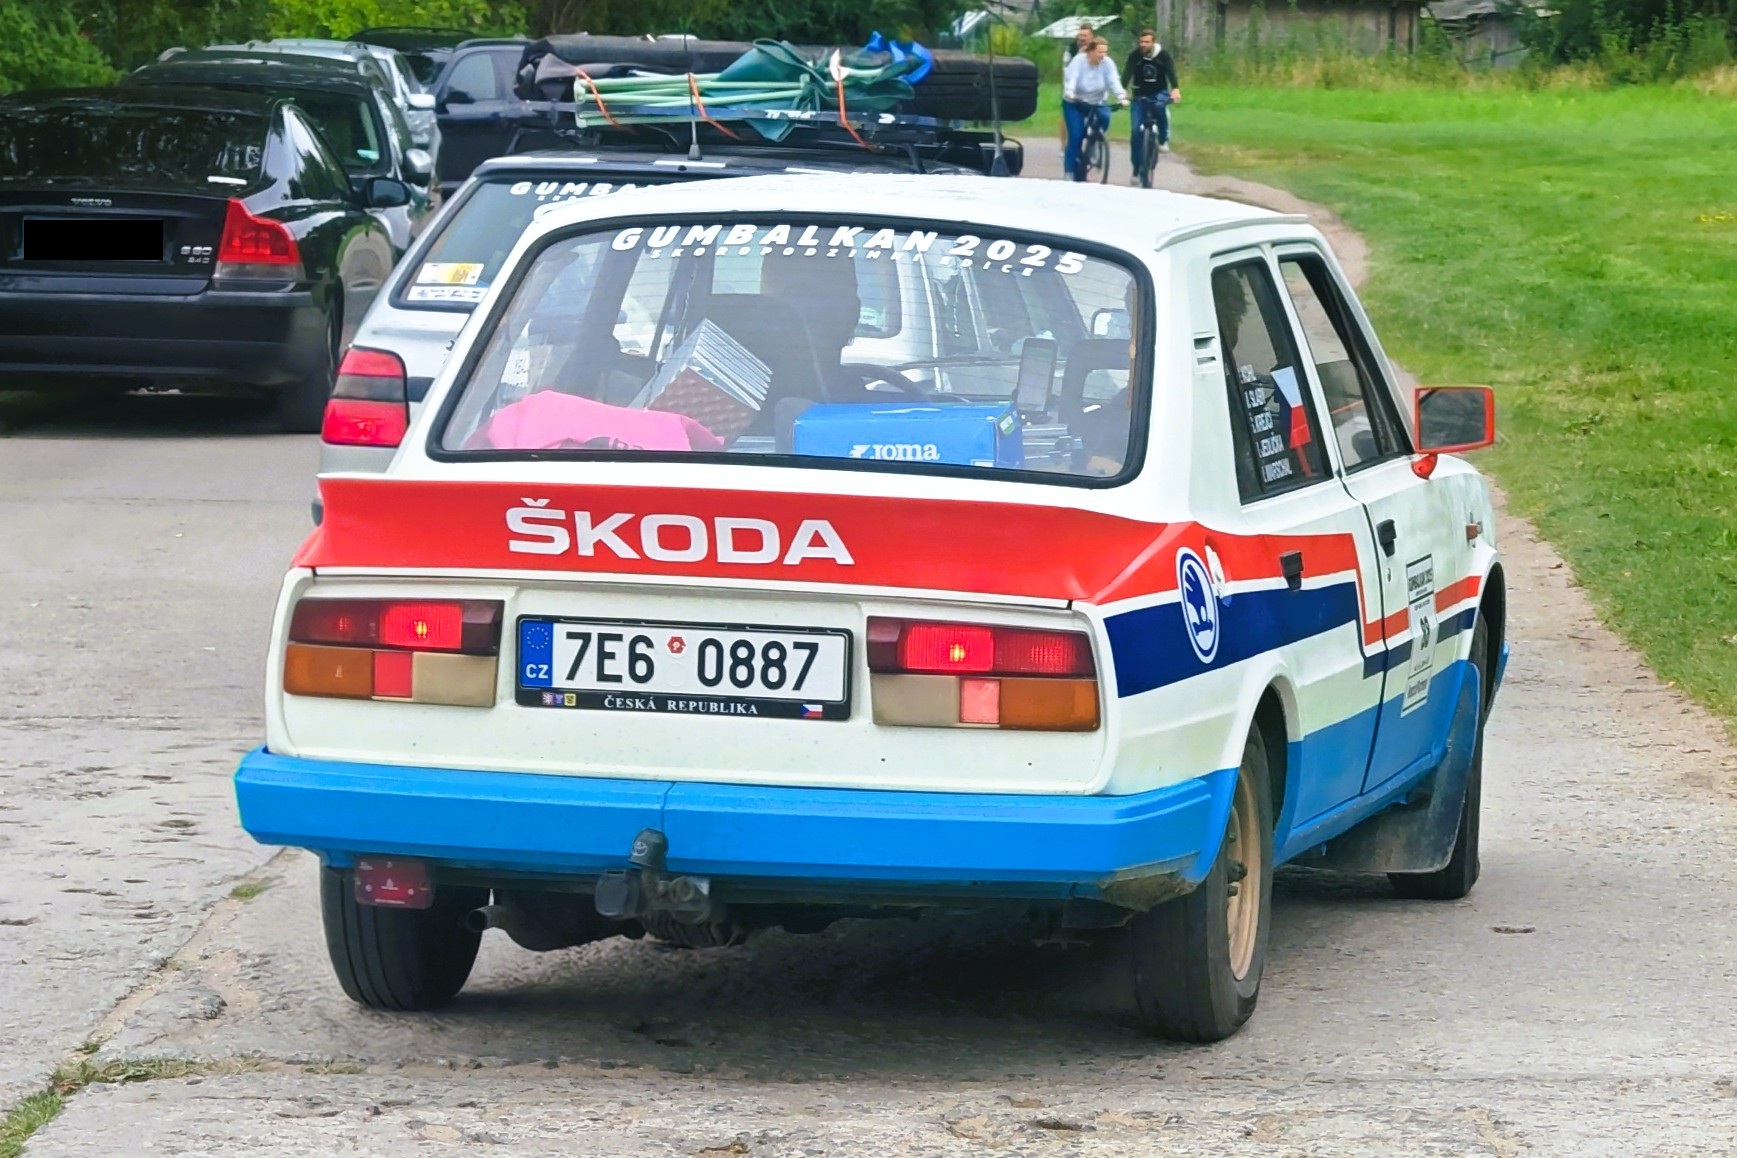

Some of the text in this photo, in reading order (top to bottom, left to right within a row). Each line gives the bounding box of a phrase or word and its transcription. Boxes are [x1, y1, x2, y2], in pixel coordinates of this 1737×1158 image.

[611, 224, 1087, 274] GUMBALKAN 2025
[504, 497, 855, 566] ŠKODA
[526, 664, 549, 679] CZ
[565, 631, 820, 691] 7E6 0887
[604, 695, 759, 715] ČESKÁ REPUBLIKA
